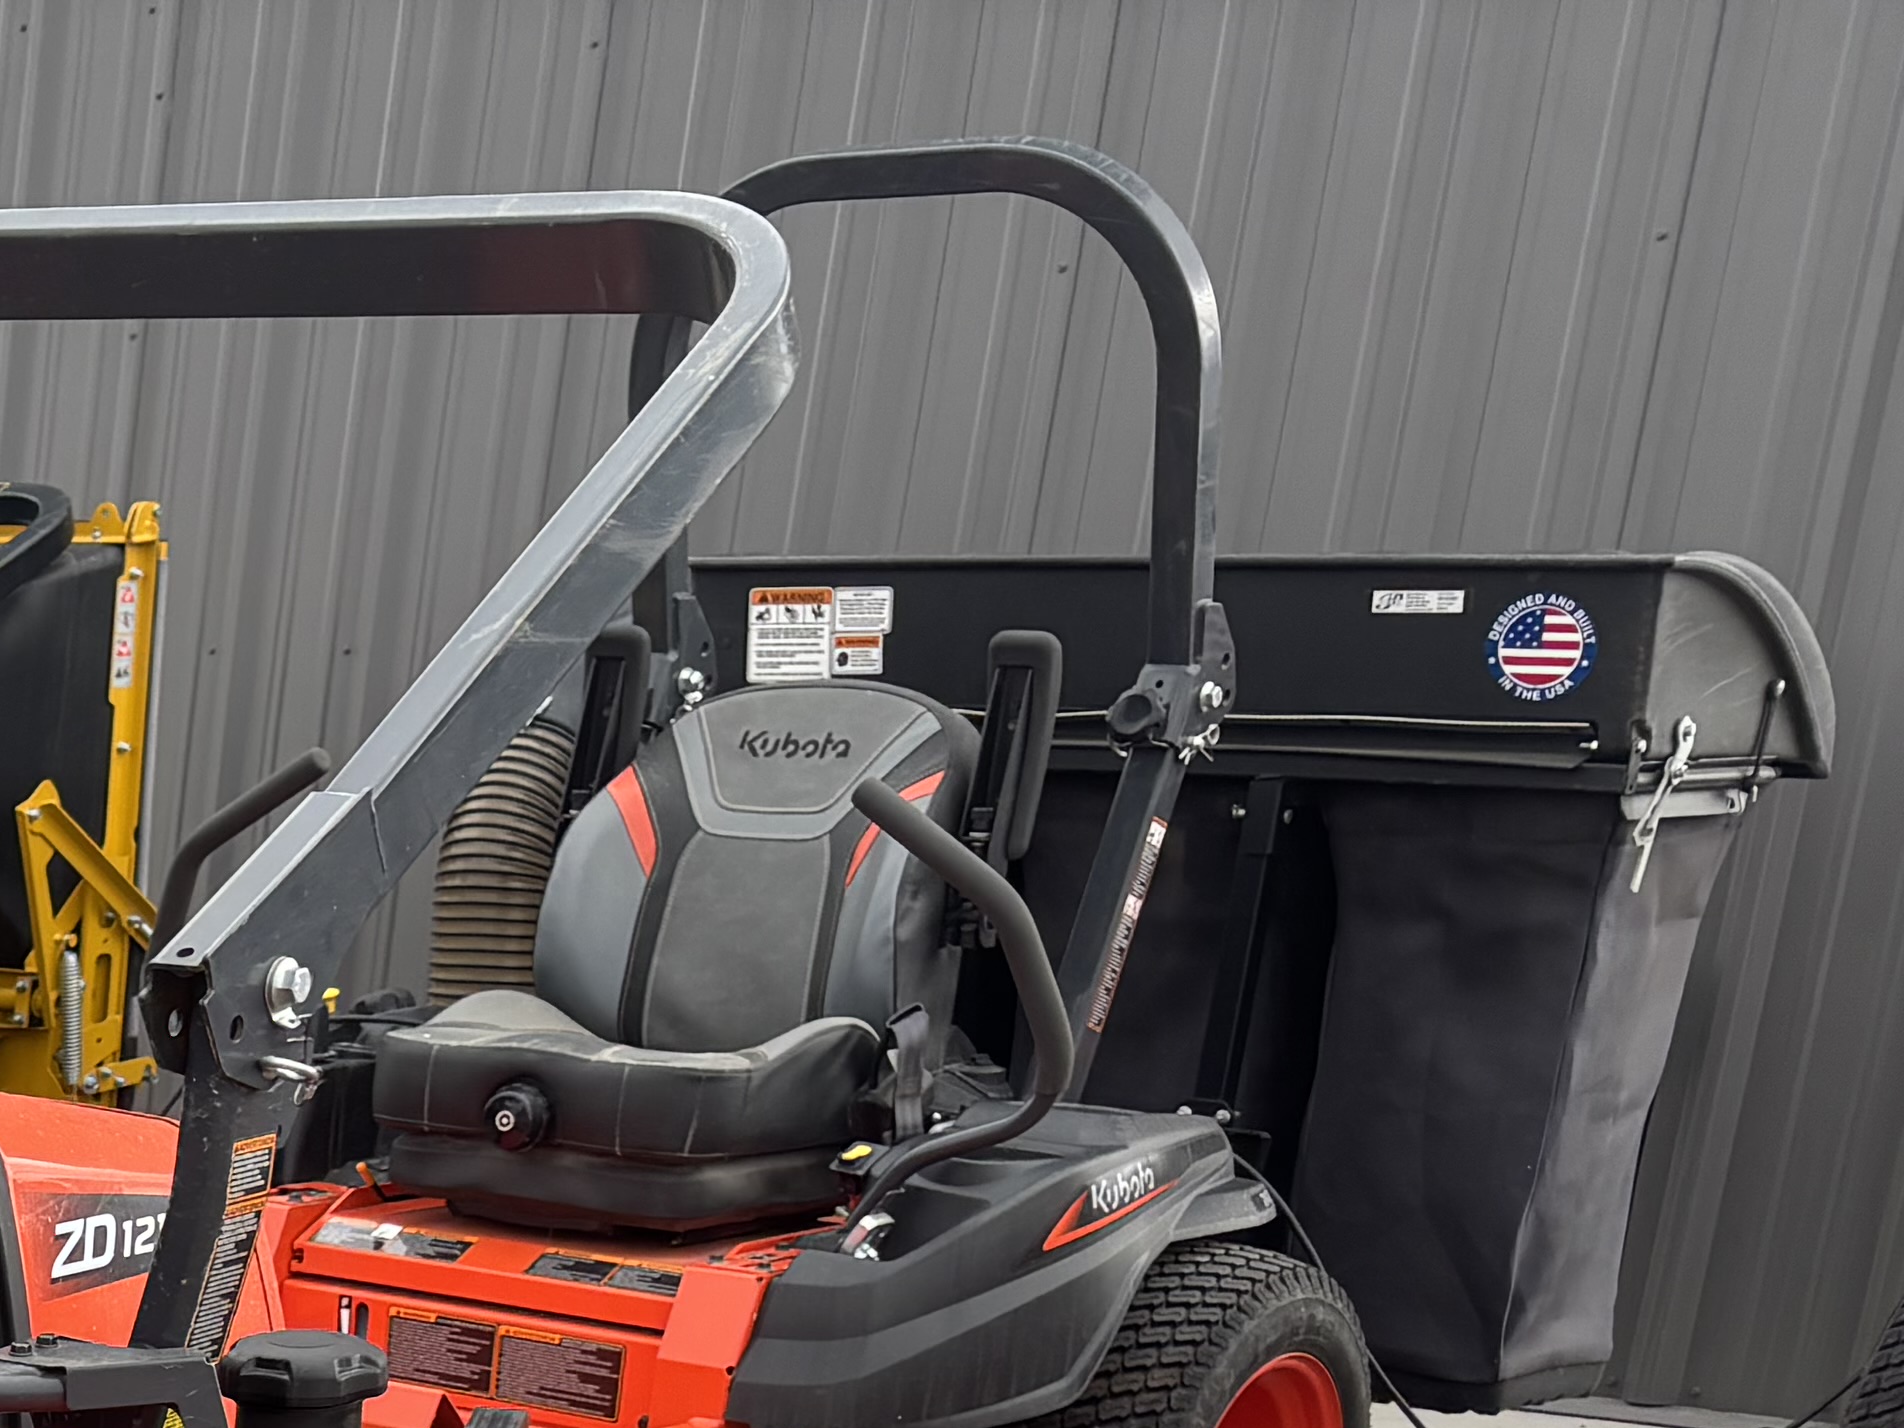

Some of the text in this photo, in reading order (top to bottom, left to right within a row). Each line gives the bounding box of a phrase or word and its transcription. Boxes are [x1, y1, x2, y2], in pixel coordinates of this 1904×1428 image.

[1488, 593, 1545, 641] DESIGNED
[1547, 593, 1576, 612] AND
[1572, 609, 1597, 645] BUILT
[1498, 675, 1575, 702] IN THE USA
[739, 728, 852, 761] Kubota
[1090, 1160, 1155, 1214] Kubota
[50, 1212, 118, 1280] ZD
